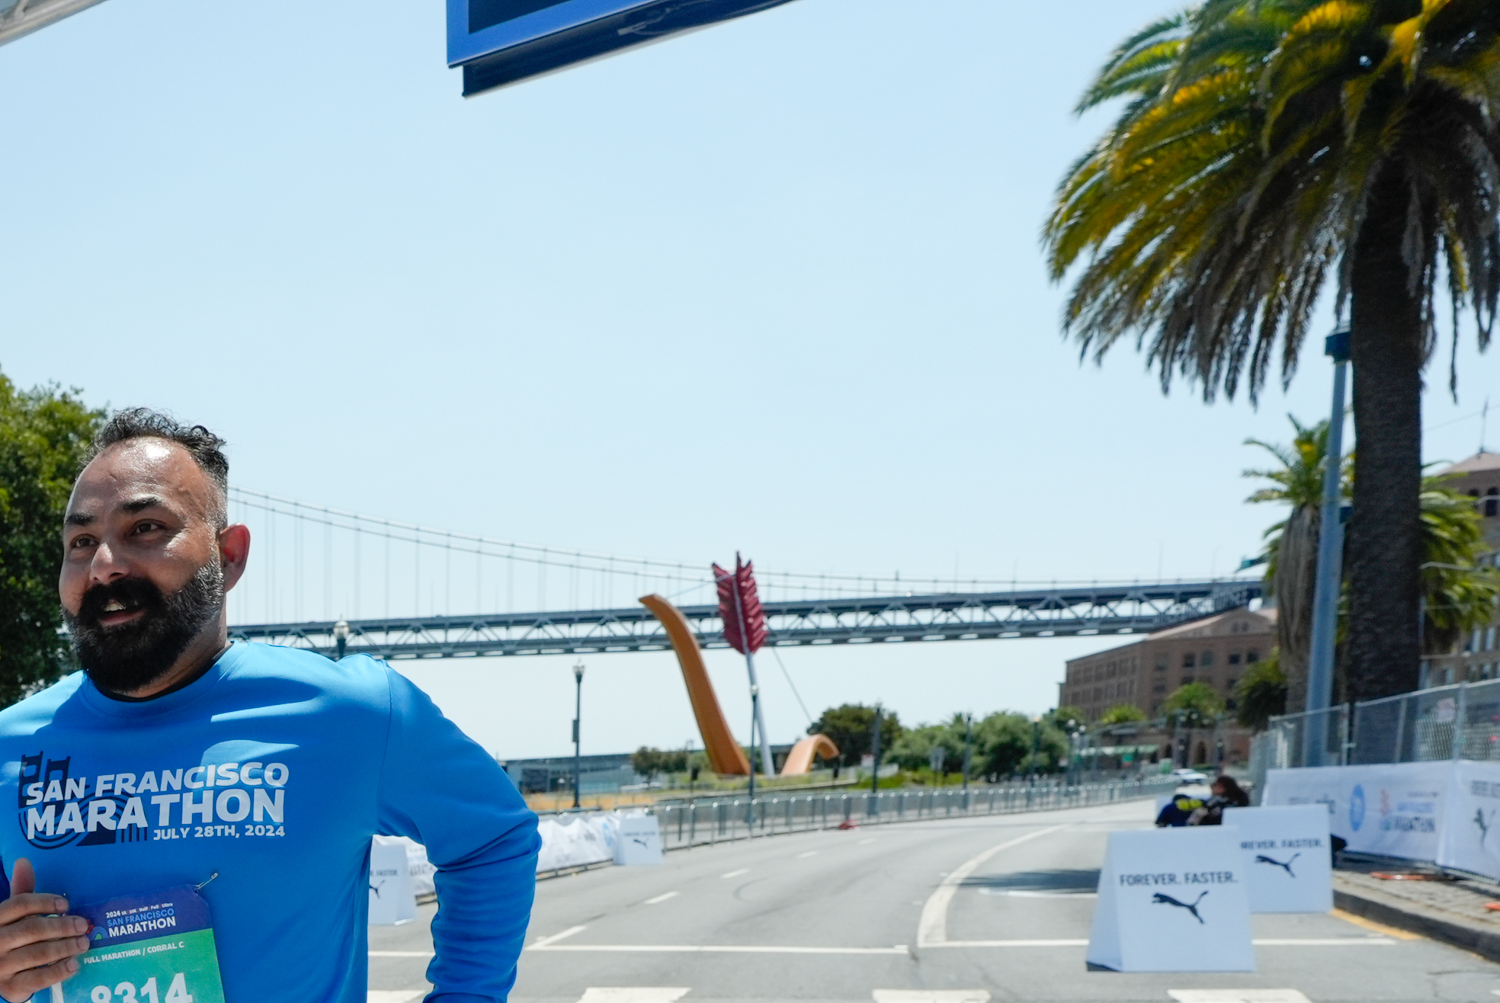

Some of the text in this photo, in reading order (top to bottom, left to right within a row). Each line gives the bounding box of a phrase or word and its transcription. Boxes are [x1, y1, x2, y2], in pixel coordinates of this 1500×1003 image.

[25, 762, 290, 806] SAN FRANCISCO
[26, 788, 286, 840] MARATHON
[153, 825, 285, 841] JULY 28TH, 2024
[1119, 871, 1238, 886] FOREVER. FASTER.
[105, 910, 121, 919] 2024
[107, 908, 175, 927] SAN FRANCISCO
[108, 916, 177, 937] MARATHON
[84, 953, 100, 965] FULL
[101, 948, 141, 961] MARATHON
[147, 942, 177, 954] CORRAL
[178, 941, 185, 949] C
